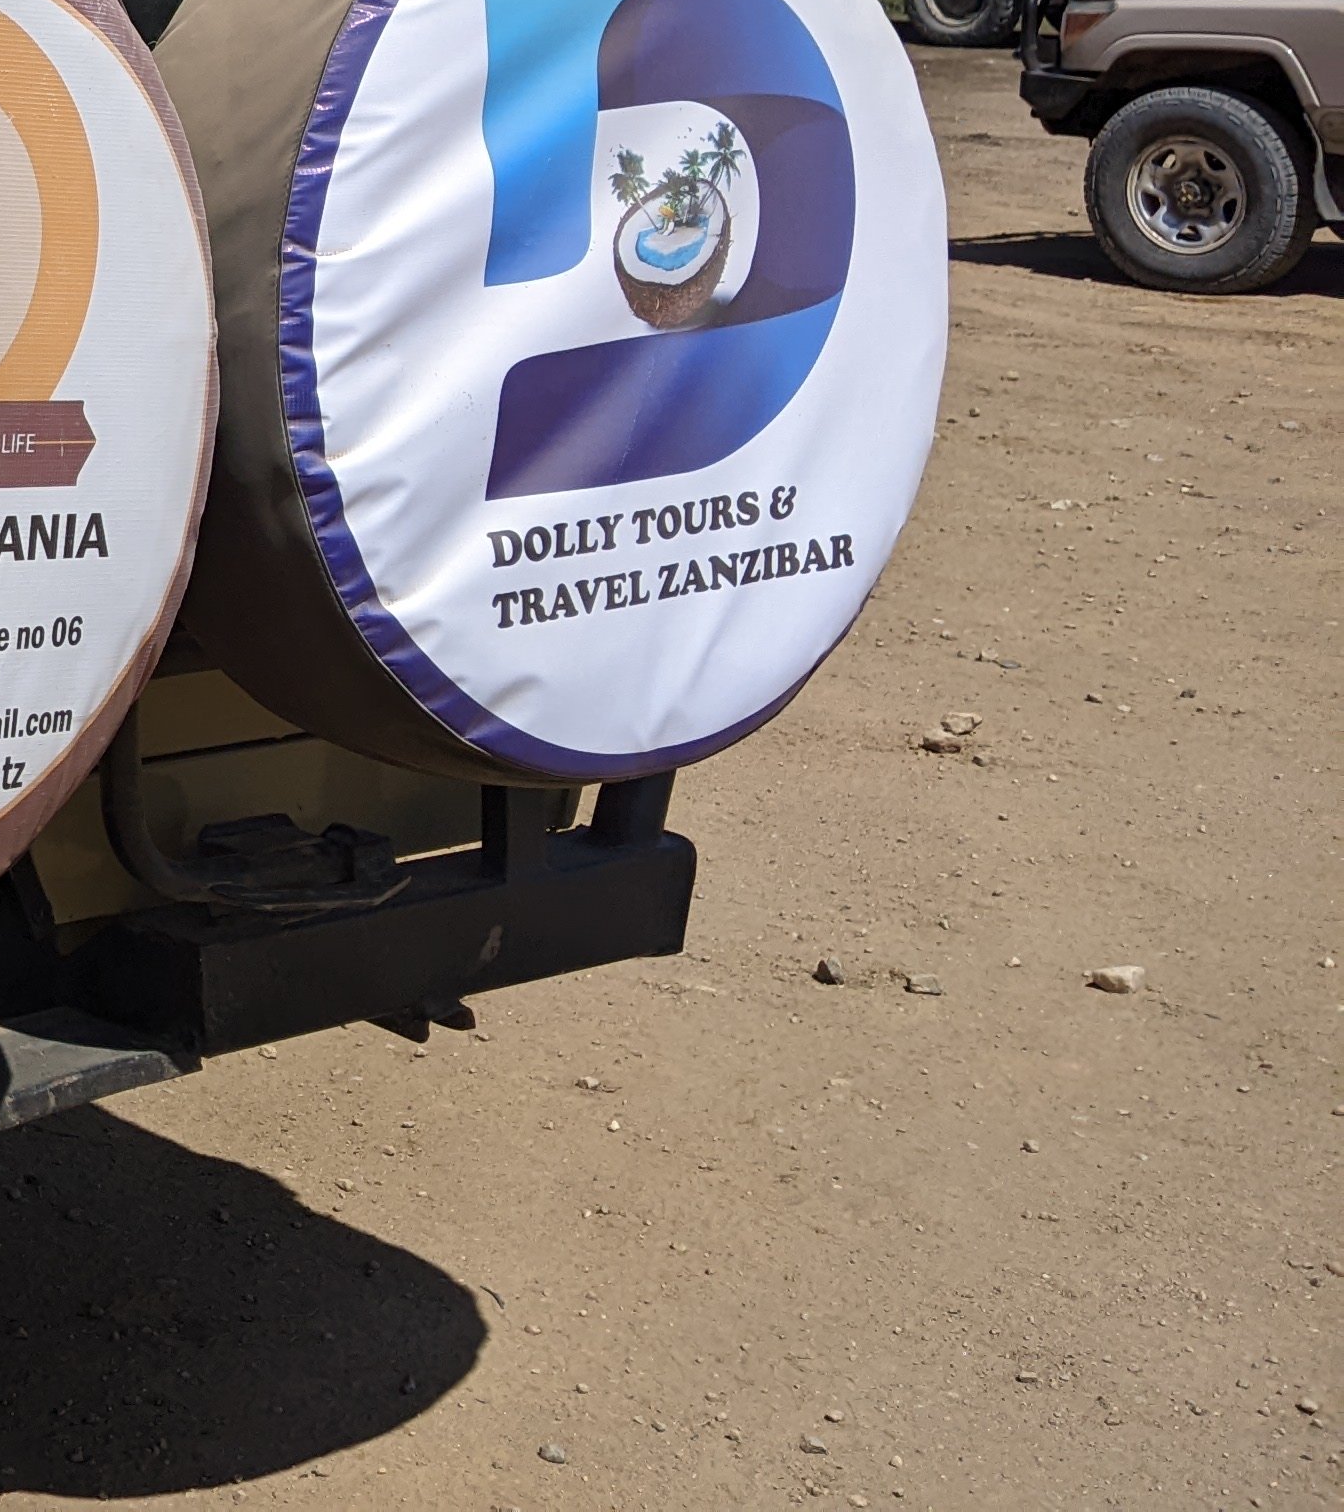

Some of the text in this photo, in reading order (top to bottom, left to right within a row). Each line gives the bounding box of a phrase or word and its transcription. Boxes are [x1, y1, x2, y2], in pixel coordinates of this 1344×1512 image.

[1, 433, 36, 454] LIFE
[486, 486, 798, 568] DOLLY TOURS &
[492, 533, 855, 628] TRAVEL ZANZIBAR
[16, 624, 45, 651] no
[51, 616, 83, 648] 06
